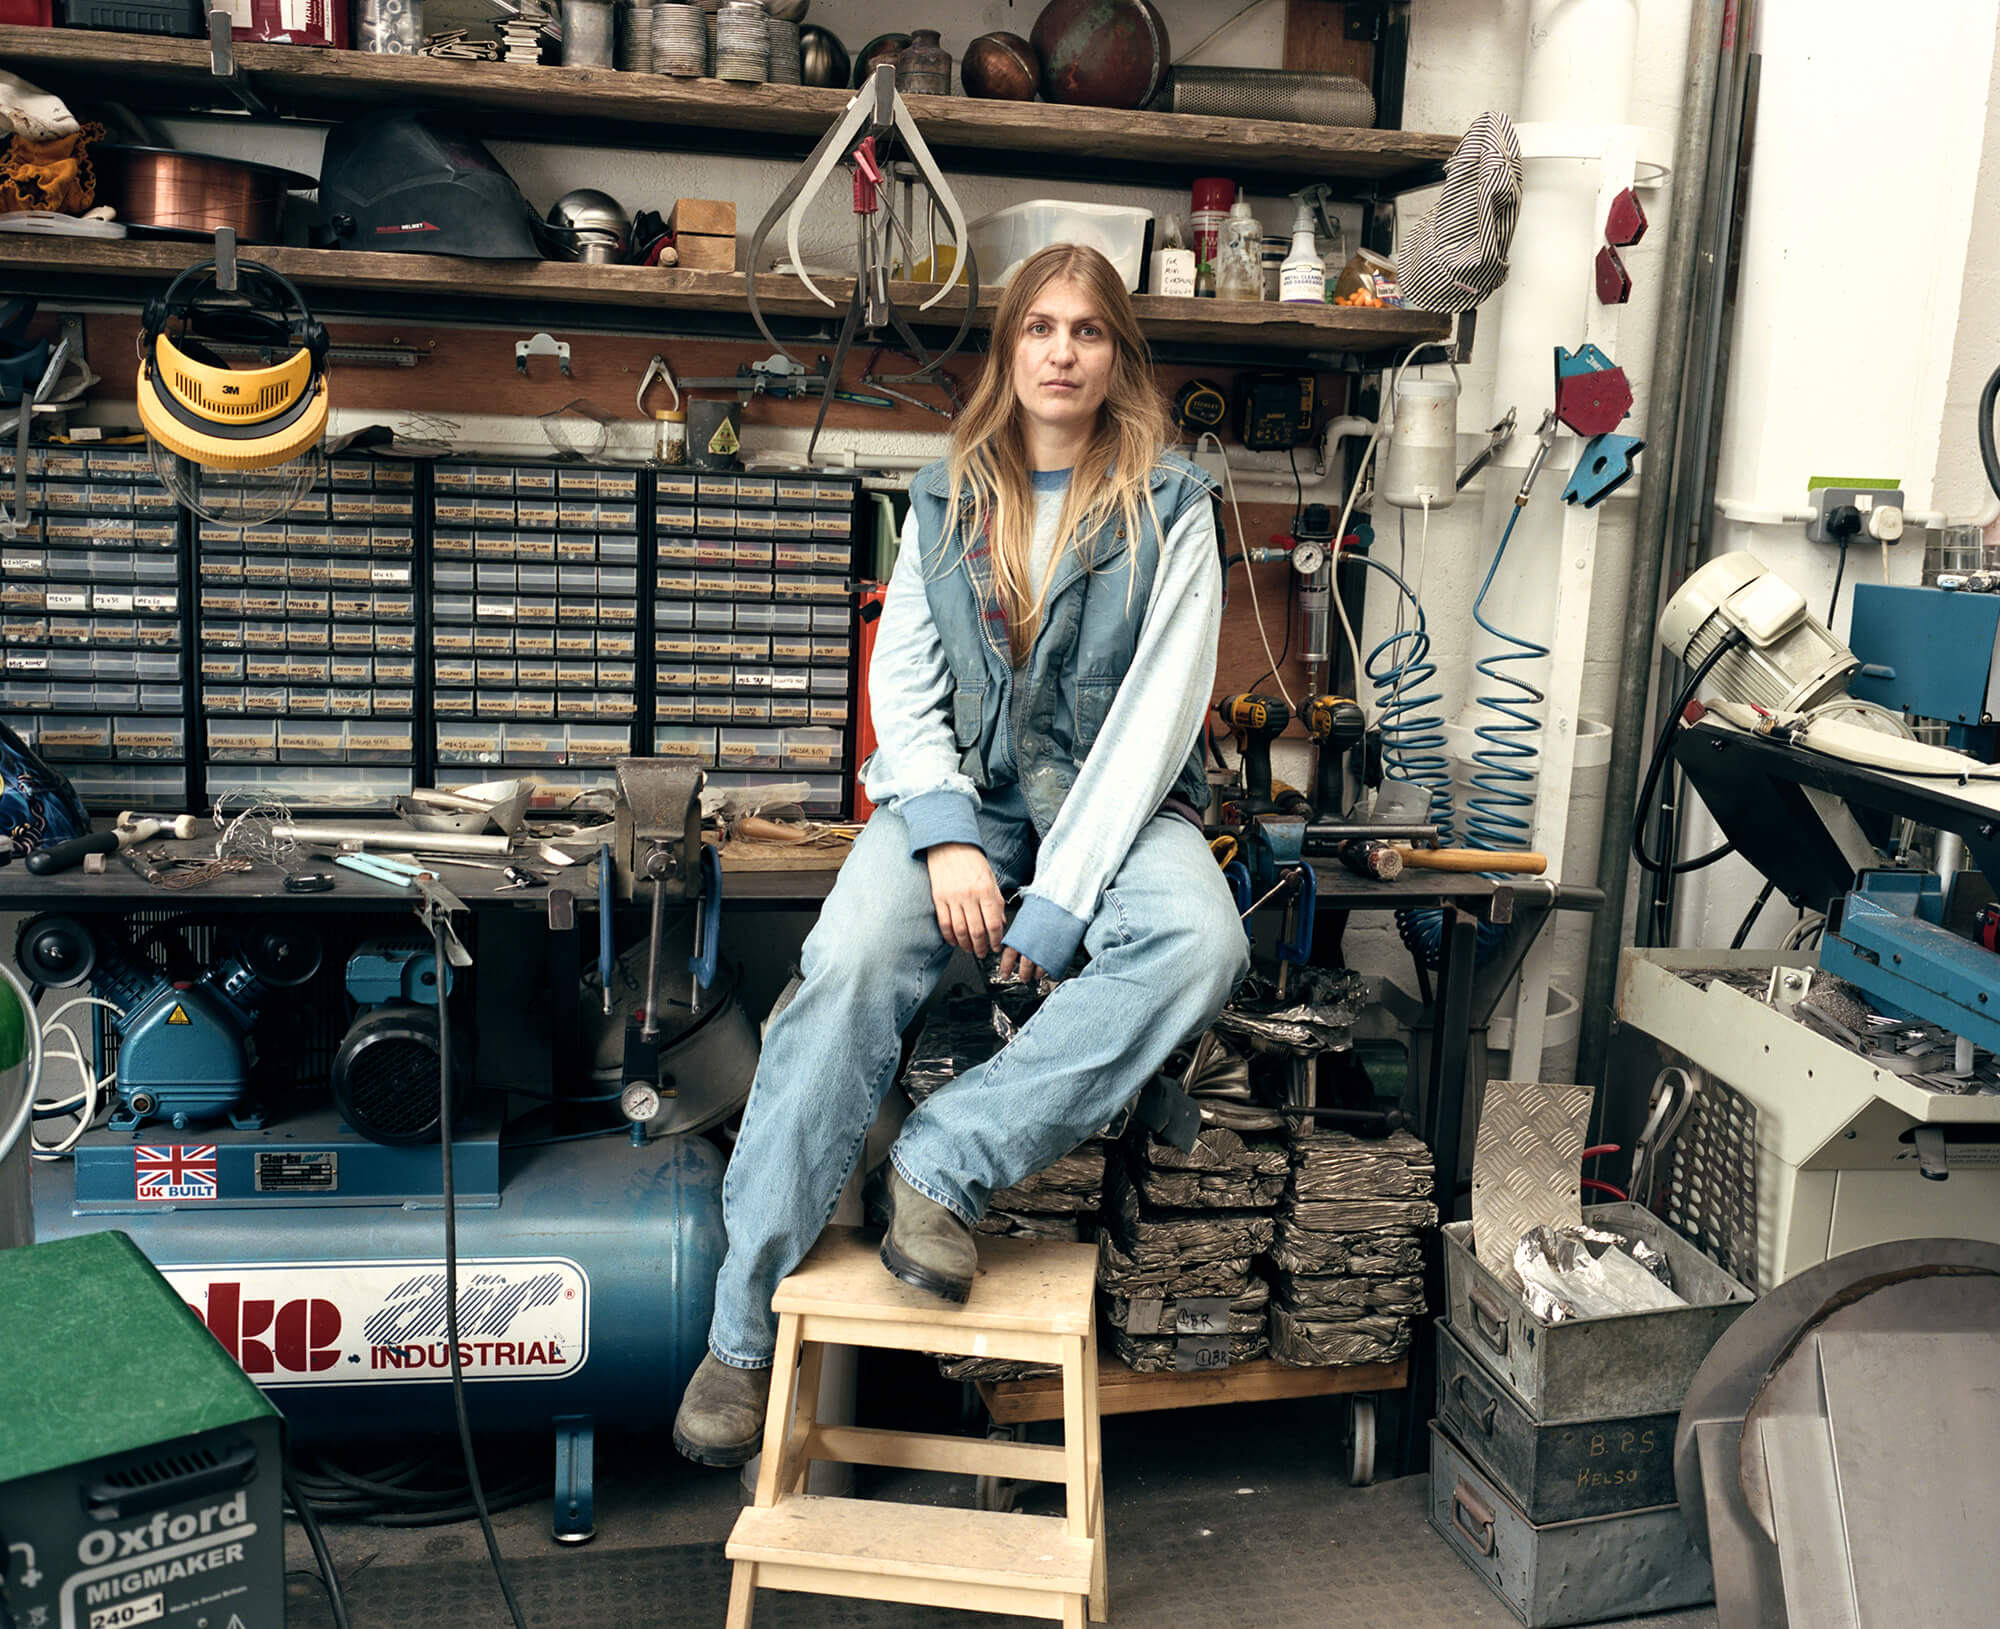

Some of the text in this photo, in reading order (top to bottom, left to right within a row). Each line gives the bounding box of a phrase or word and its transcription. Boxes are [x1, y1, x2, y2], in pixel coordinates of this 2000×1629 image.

[222, 385, 240, 395] 3M
[261, 1153, 301, 1164] Clarke
[139, 1185, 214, 1197] UK BUILT
[192, 1282, 342, 1373] ke
[371, 1341, 567, 1370] INDUSTRIAL
[77, 1490, 248, 1566] Oxford
[86, 1543, 245, 1605] MIGMAKER
[92, 1597, 162, 1629] 240-1
